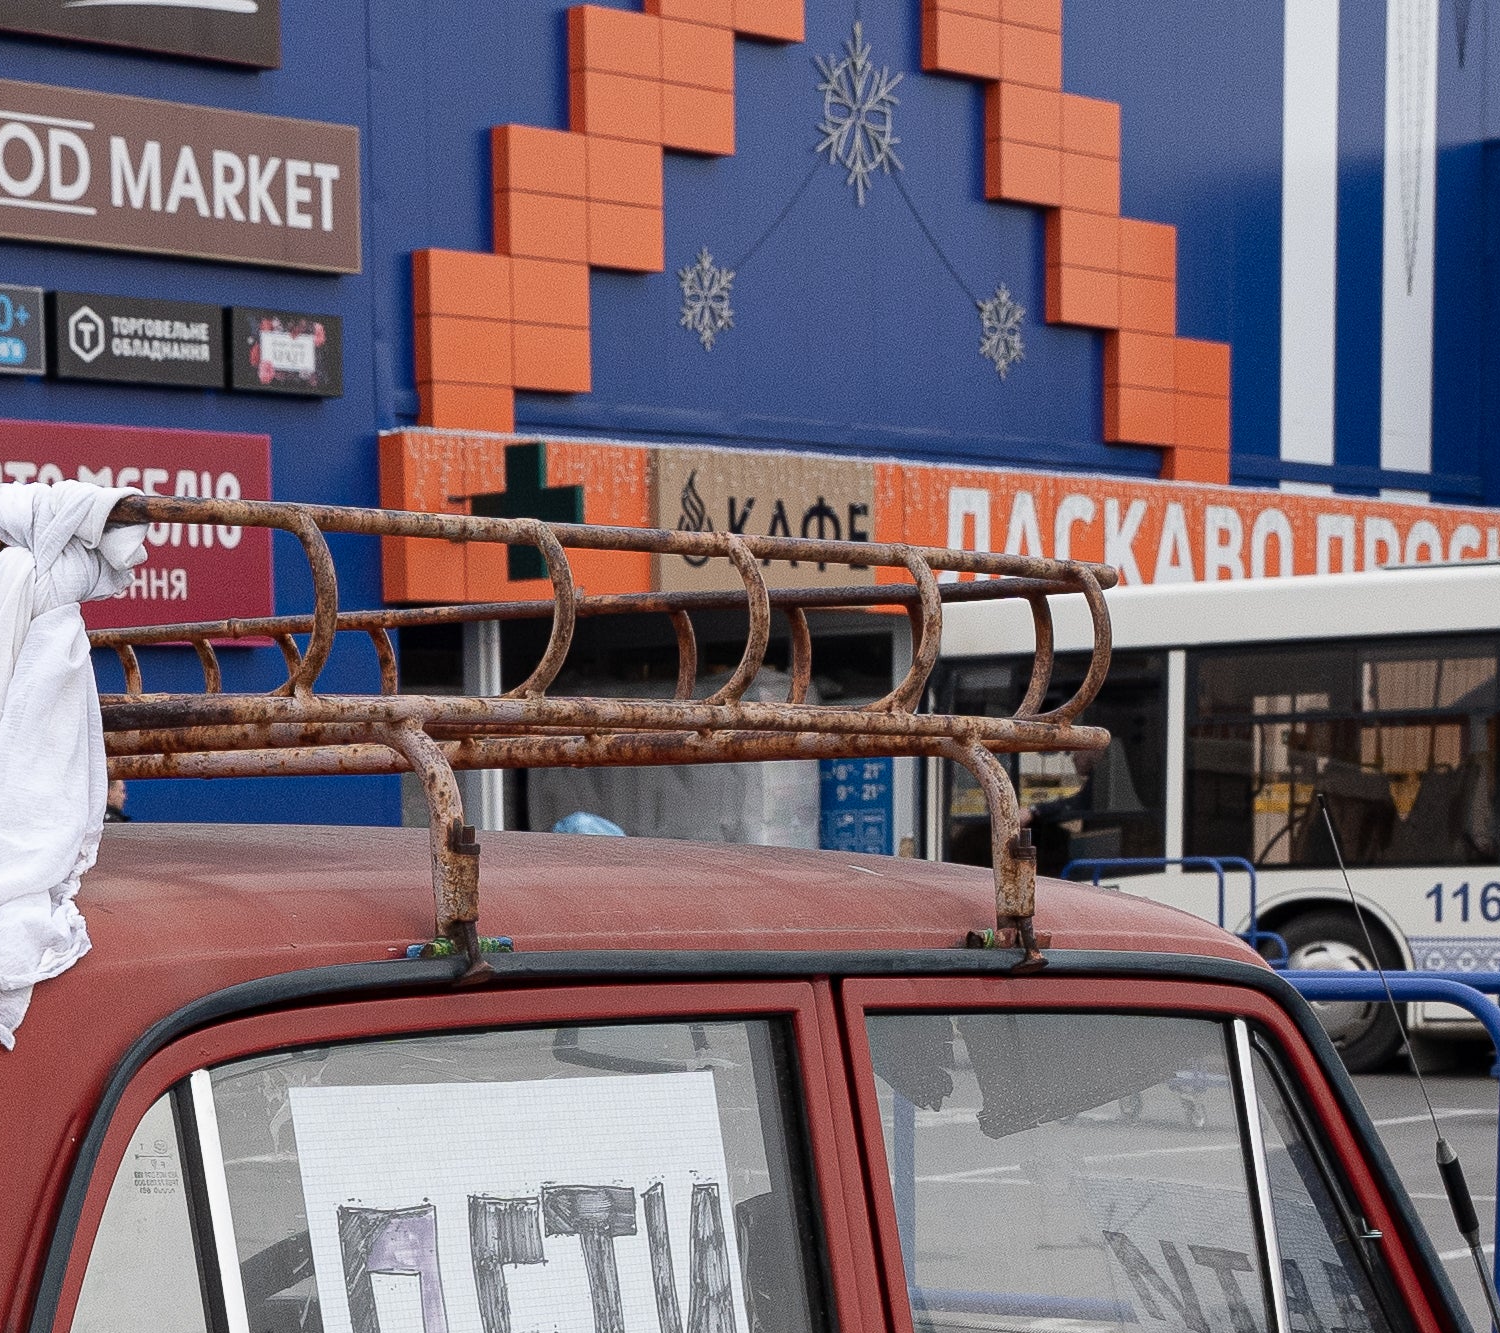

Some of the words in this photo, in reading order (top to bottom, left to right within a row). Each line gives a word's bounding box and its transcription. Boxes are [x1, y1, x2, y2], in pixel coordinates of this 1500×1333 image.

[109, 135, 341, 233] MARKET
[110, 315, 210, 342] ТОРГОВЕЛЬНЕ
[111, 337, 211, 363] ОБЛАДНАННЯ
[727, 495, 869, 573] КАФЕ
[936, 486, 1295, 586] ЛАСКАВО
